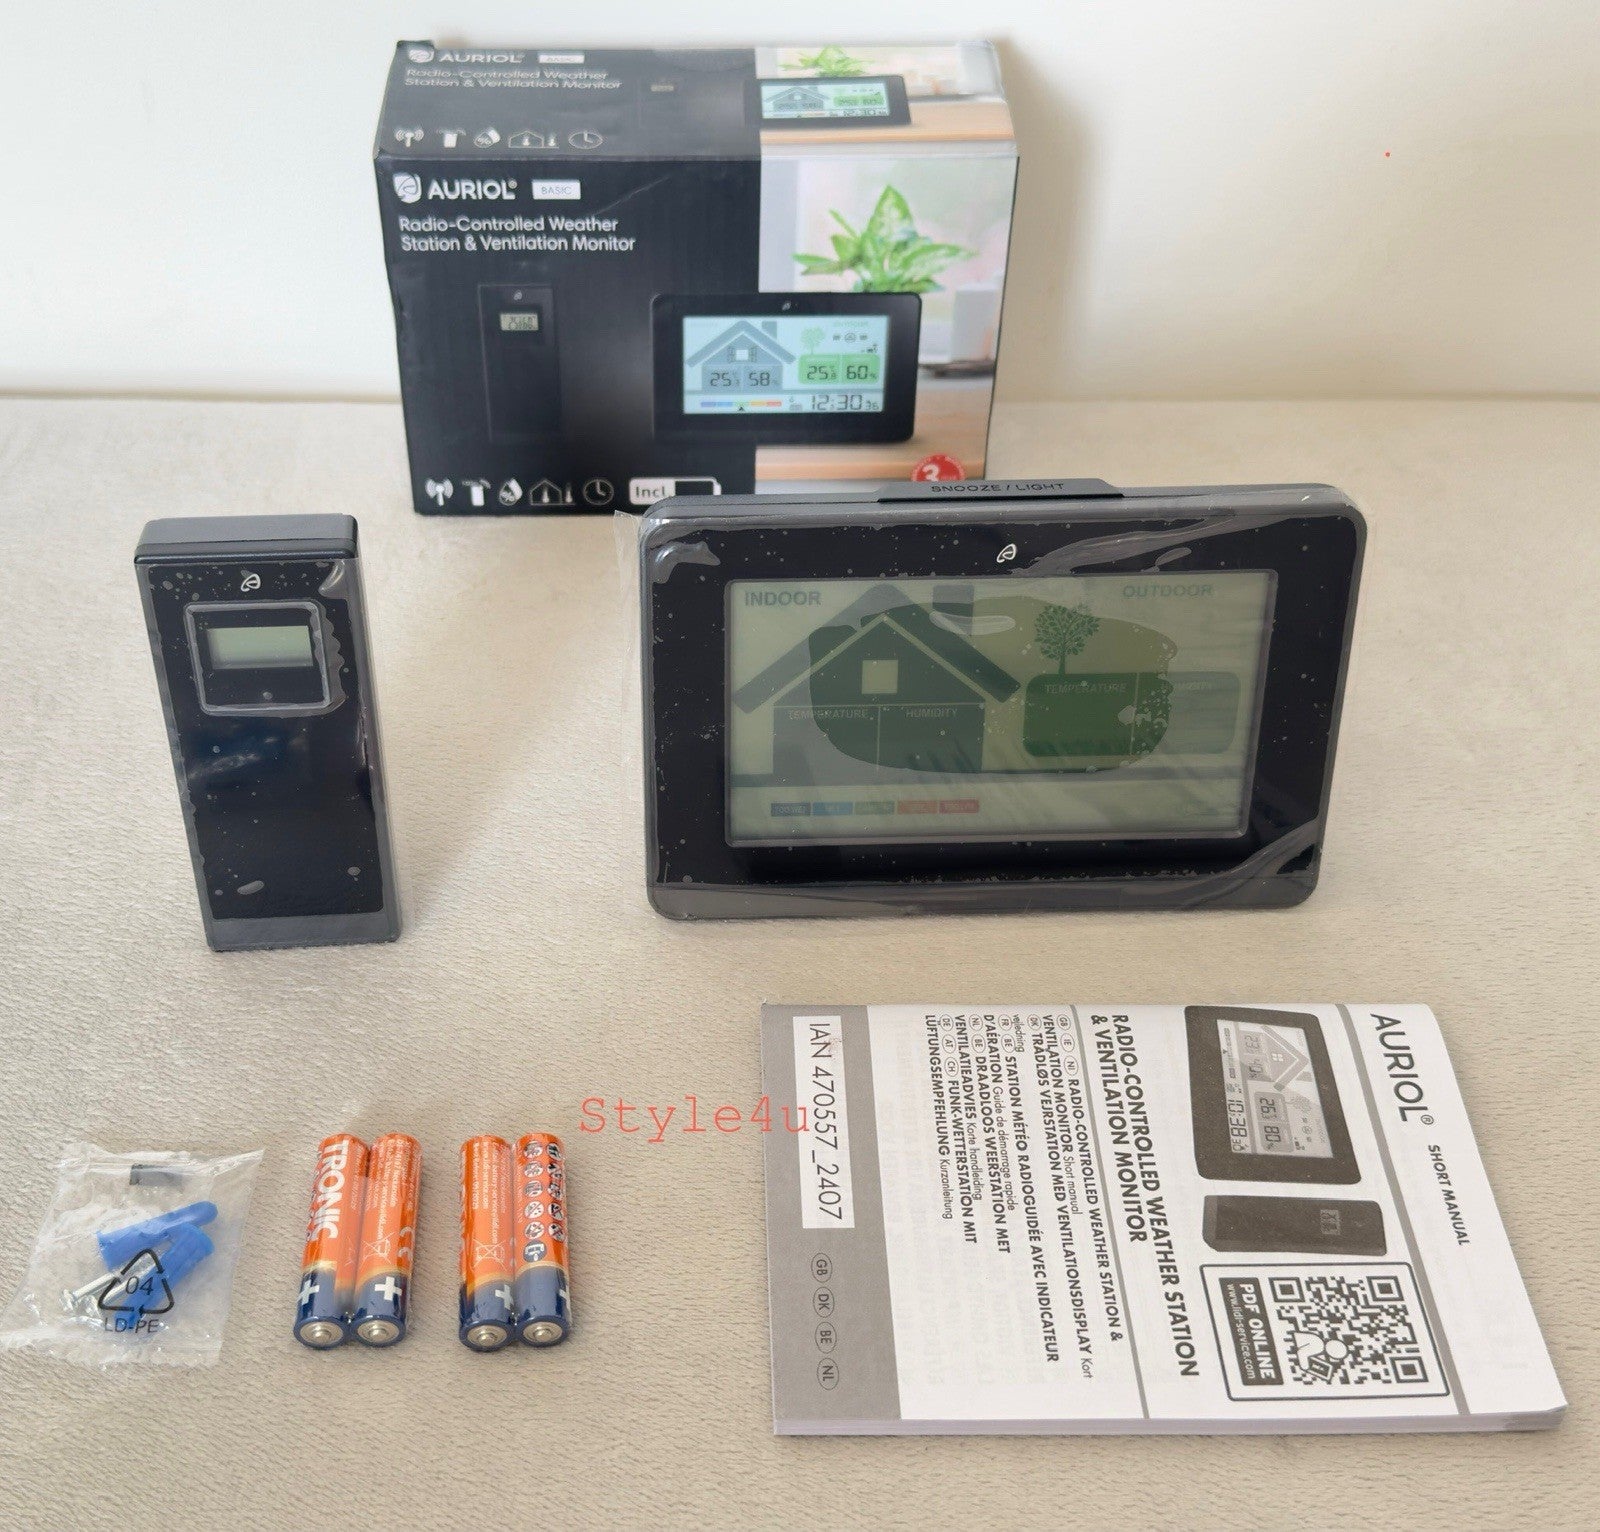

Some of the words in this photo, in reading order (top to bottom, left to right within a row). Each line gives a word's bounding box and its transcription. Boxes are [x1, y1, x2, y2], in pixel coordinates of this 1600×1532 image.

[404, 78, 460, 88] Station
[464, 79, 476, 88] &
[479, 79, 560, 89] Ventilation
[563, 80, 623, 90] Monitor
[406, 69, 540, 80] Radio-Controlled
[544, 70, 610, 80] Weather
[541, 185, 572, 195] BASIC
[399, 216, 545, 233] Radio-Controlled
[549, 216, 619, 233] Weather
[401, 235, 460, 251] Station
[464, 236, 478, 251] &
[480, 235, 569, 251] Ventilation
[572, 236, 636, 251] Monitor
[811, 394, 863, 411] 12:30
[931, 484, 1002, 493] SNOOZE
[1015, 482, 1065, 491] LIGHT
[744, 590, 822, 607] INDOOR
[1122, 583, 1215, 599] OUTDOOR
[1045, 682, 1128, 695] TEMPERATURE
[905, 707, 958, 719] HUMIDITY
[1012, 1014, 1026, 1053] vejledning
[1091, 1014, 1108, 1026] &
[809, 1023, 832, 1058] IAN
[1043, 1014, 1064, 1089] VENTILATION
[955, 1014, 977, 1119] VENTILATIEADVIES
[1005, 1056, 1021, 1107] STATION
[975, 1056, 995, 1133] DRAADLOOS
[993, 1086, 1006, 1114] Guide
[1095, 1029, 1130, 1145] VENTILATION
[925, 1014, 950, 1156] LÜFTUNGSEMPFEHLUNG
[940, 1159, 954, 1220] Kurzanleitung
[967, 1122, 978, 1145] Korte
[996, 1116, 1007, 1127] de
[1012, 1110, 1030, 1152] MÉTÉO
[1040, 1089, 1062, 1171] VEJRSTATION
[1054, 1092, 1073, 1153] MONITOR
[1228, 1099, 1247, 1138] 10:38
[812, 1065, 843, 1220] 470557_2407
[948, 1080, 974, 1217] FUNK-WETTERSTATION
[963, 1221, 977, 1243] MIT
[998, 1131, 1011, 1179] démarrage
[1068, 1079, 1098, 1205] RADIO-CONTROLLED
[970, 1148, 984, 1201] handleiding
[984, 1136, 1006, 1224] WEERSTATION
[1063, 1156, 1075, 1179] Short
[308, 1139, 350, 1242] TRONIC
[1002, 1181, 1018, 1211] rapide
[1018, 1154, 1044, 1242] RADIOGUIDÉE
[1052, 1174, 1067, 1202] MED
[1067, 1181, 1083, 1215] manual
[1112, 1014, 1161, 1192] RADIO-CONTROLLED
[1146, 1196, 1180, 1286] WEATHER
[1164, 1291, 1200, 1377] STATION
[1114, 1151, 1148, 1242] MONITOR
[1428, 1144, 1451, 1187] SHORT
[1441, 1188, 1472, 1246] MANUAL
[996, 1228, 1010, 1253] MET
[1089, 1207, 1110, 1268] WEATHER
[1030, 1245, 1047, 1279] AVEC
[1057, 1205, 1092, 1354] VENTILATIONSDISPLAY
[125, 1276, 154, 1296] 04
[1100, 1272, 1121, 1328] STATION
[1239, 1283, 1261, 1315] PDF
[104, 1317, 159, 1334] LD-PE
[1036, 1282, 1059, 1362] INDICATEUR
[1110, 1331, 1123, 1341] &
[1227, 1283, 1256, 1380] www.lidl-service.com
[1081, 1358, 1093, 1379] Kort
[1248, 1318, 1276, 1380] ONLINE
